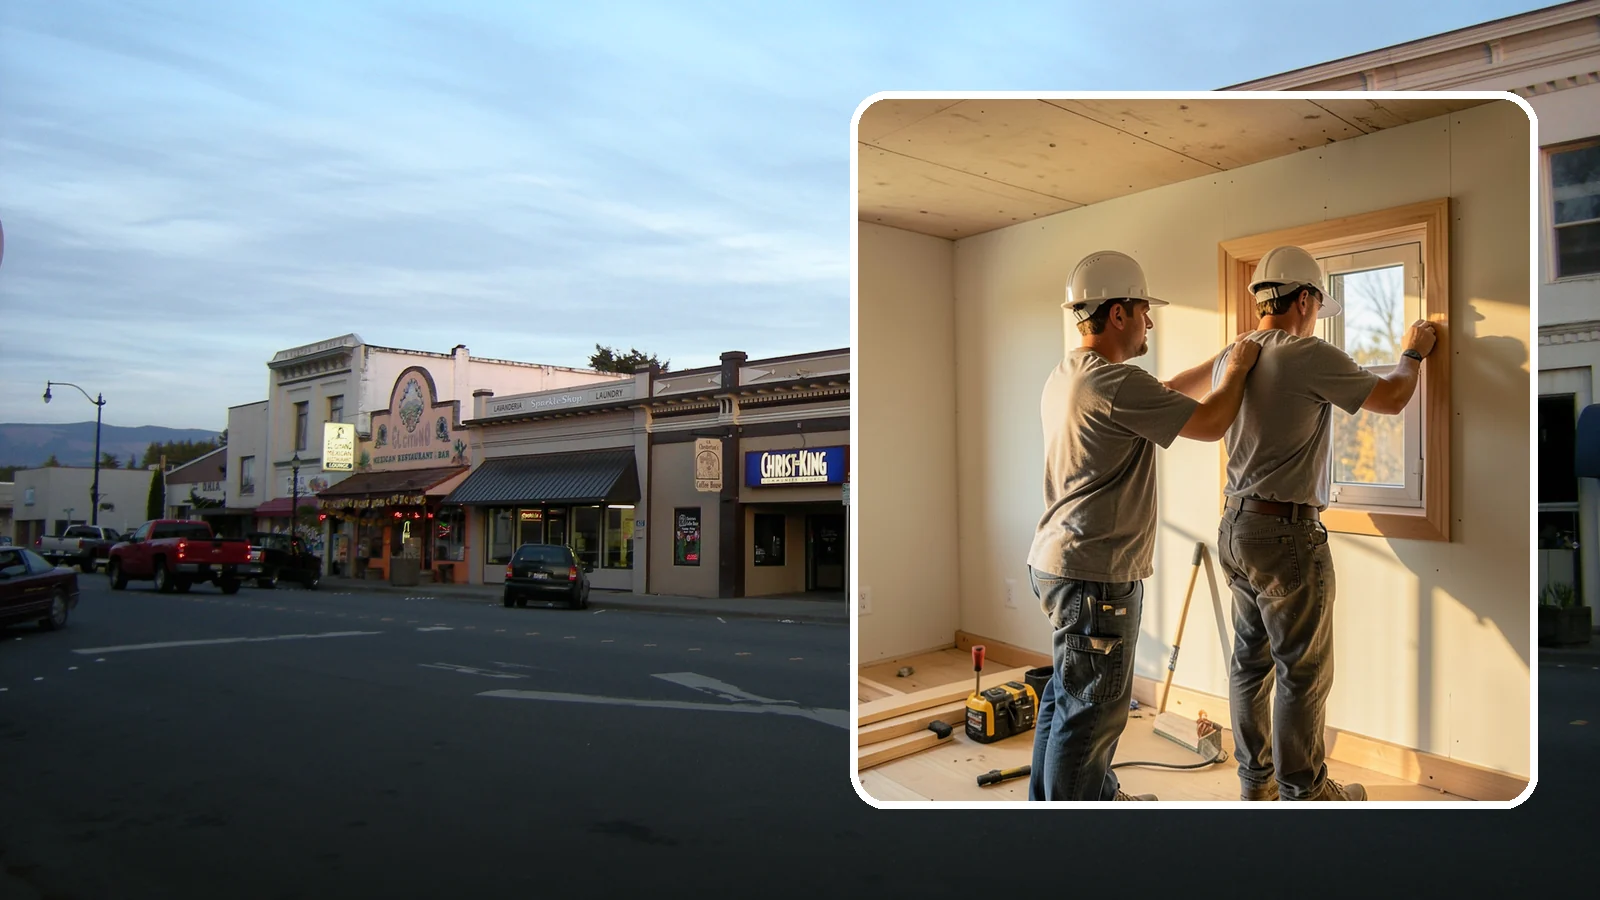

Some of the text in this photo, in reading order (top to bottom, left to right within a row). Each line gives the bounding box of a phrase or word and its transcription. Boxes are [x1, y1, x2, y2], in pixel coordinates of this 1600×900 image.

[530, 394, 583, 409] Sparkle Shop
[595, 389, 624, 400] LAUNDRY
[493, 402, 522, 413] LAVANDERIA
[373, 450, 450, 464] MEXICAN RESTAURANT BAR
[760, 450, 827, 478] CHRIST KING
